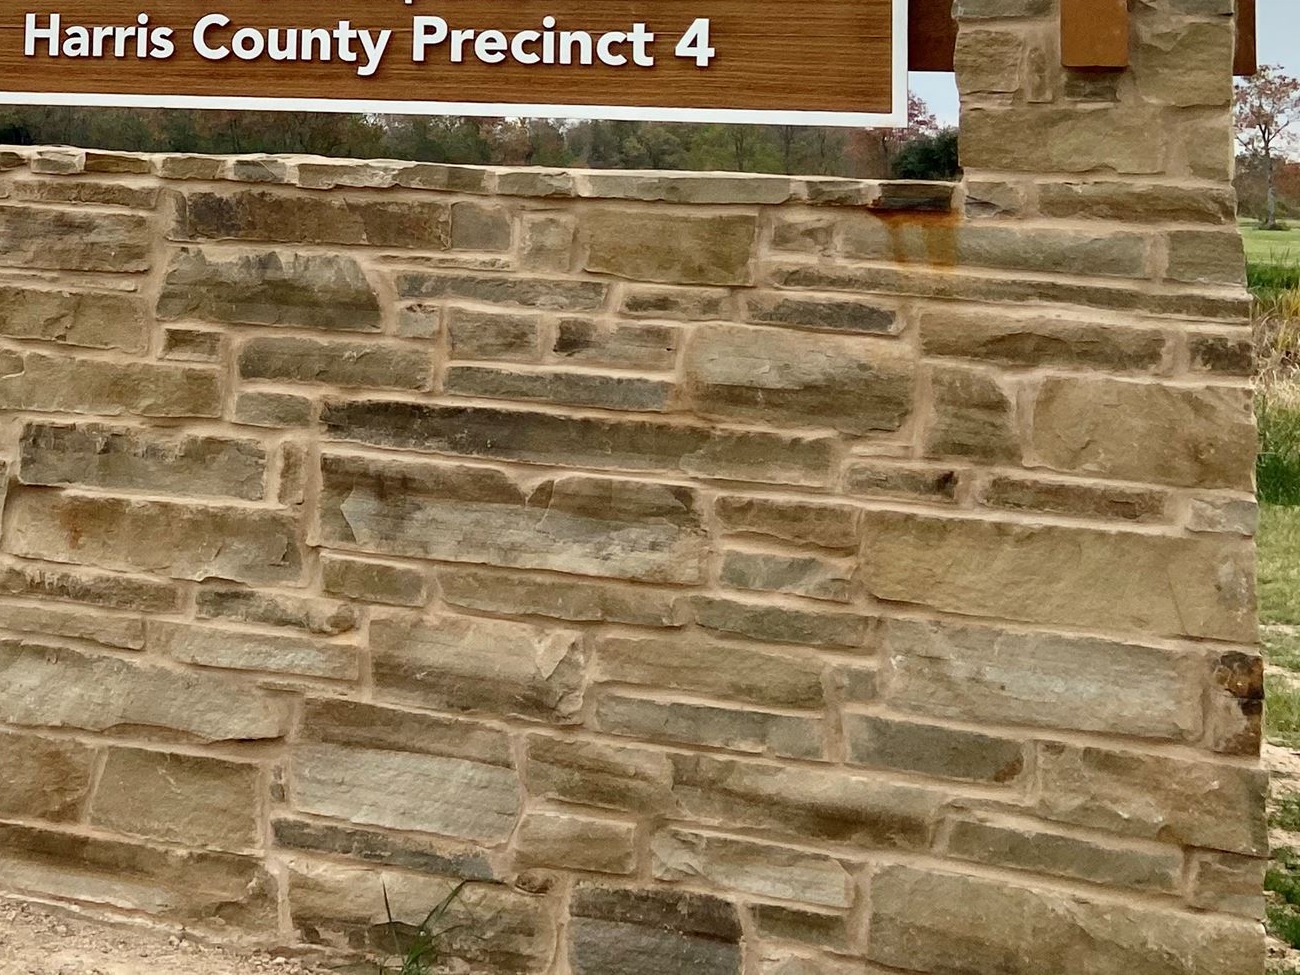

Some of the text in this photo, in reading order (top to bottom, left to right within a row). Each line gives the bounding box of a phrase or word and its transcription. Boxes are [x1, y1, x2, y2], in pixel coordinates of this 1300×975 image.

[24, 13, 715, 76] Harris County Precinct 4
